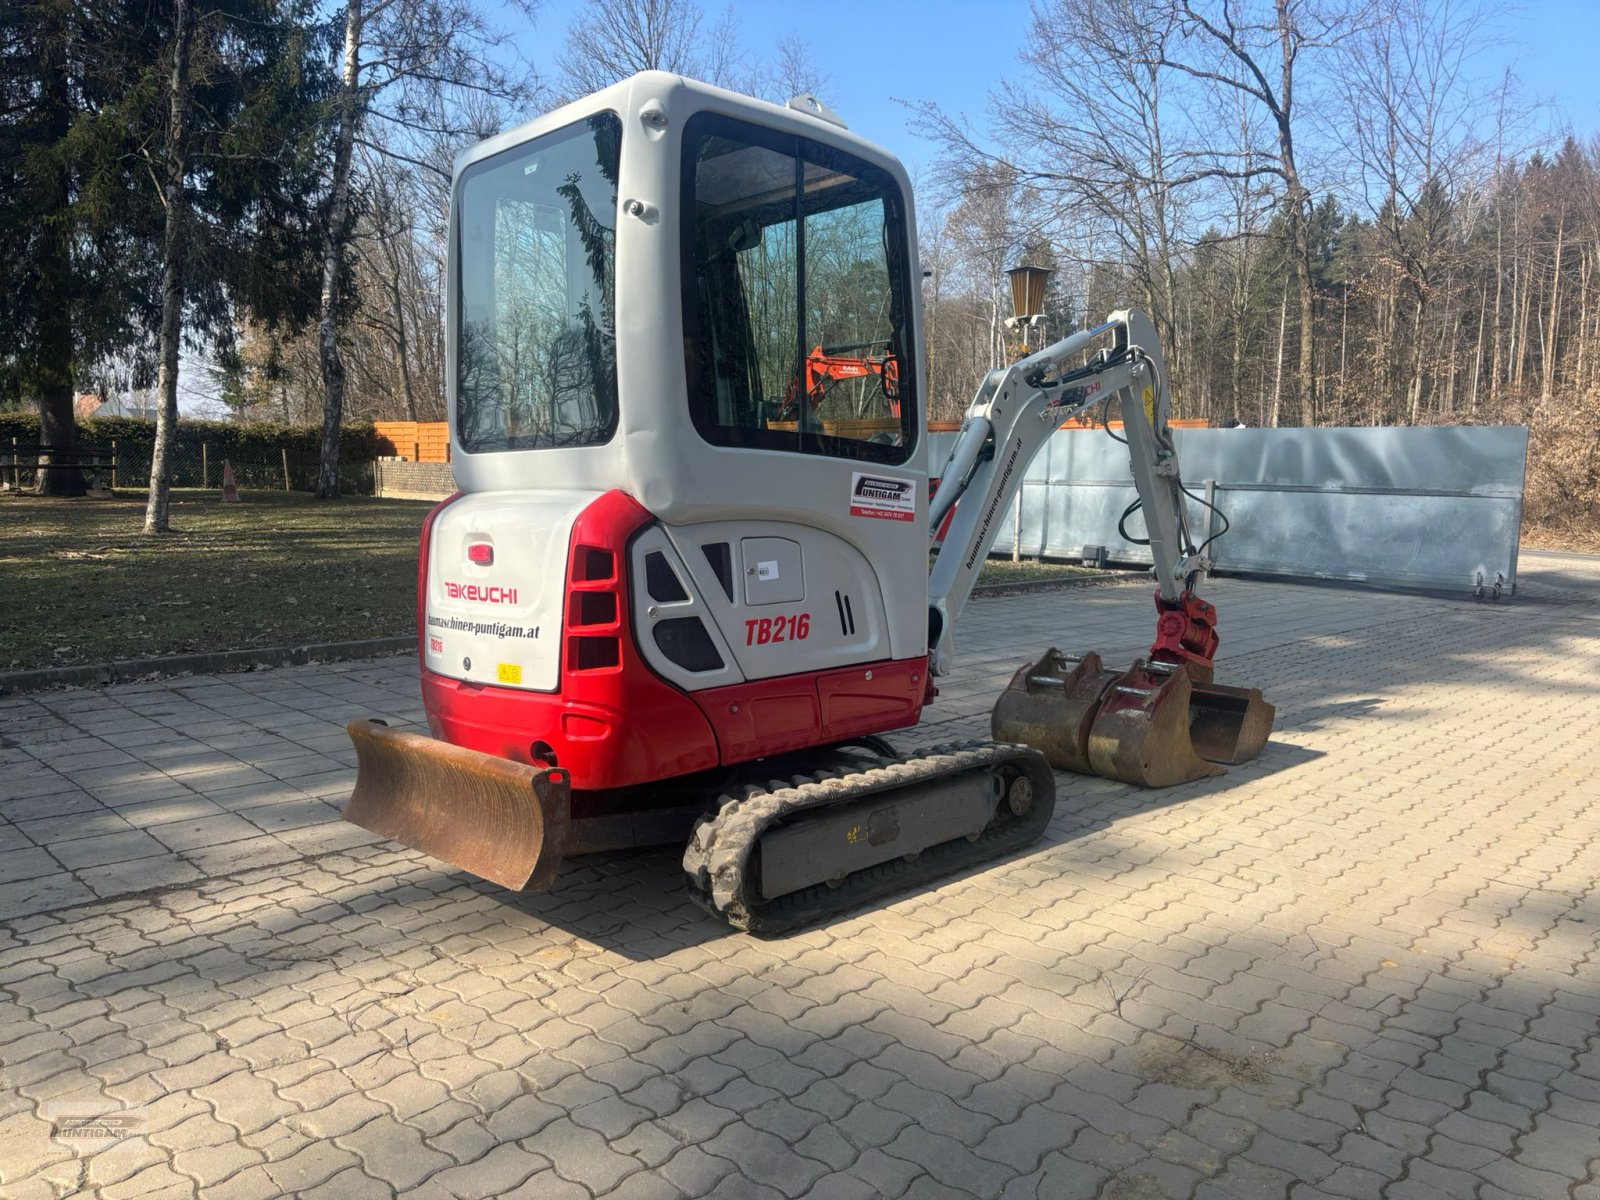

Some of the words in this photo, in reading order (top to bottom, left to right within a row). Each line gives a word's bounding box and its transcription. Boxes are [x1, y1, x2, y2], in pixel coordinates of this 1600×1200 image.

[966, 437, 1023, 570] baumaschinen-puntigam.at
[444, 582, 518, 605] TAKEUCHI
[427, 613, 540, 639] baumaschinen-puntigam.at
[745, 613, 811, 647] TB216
